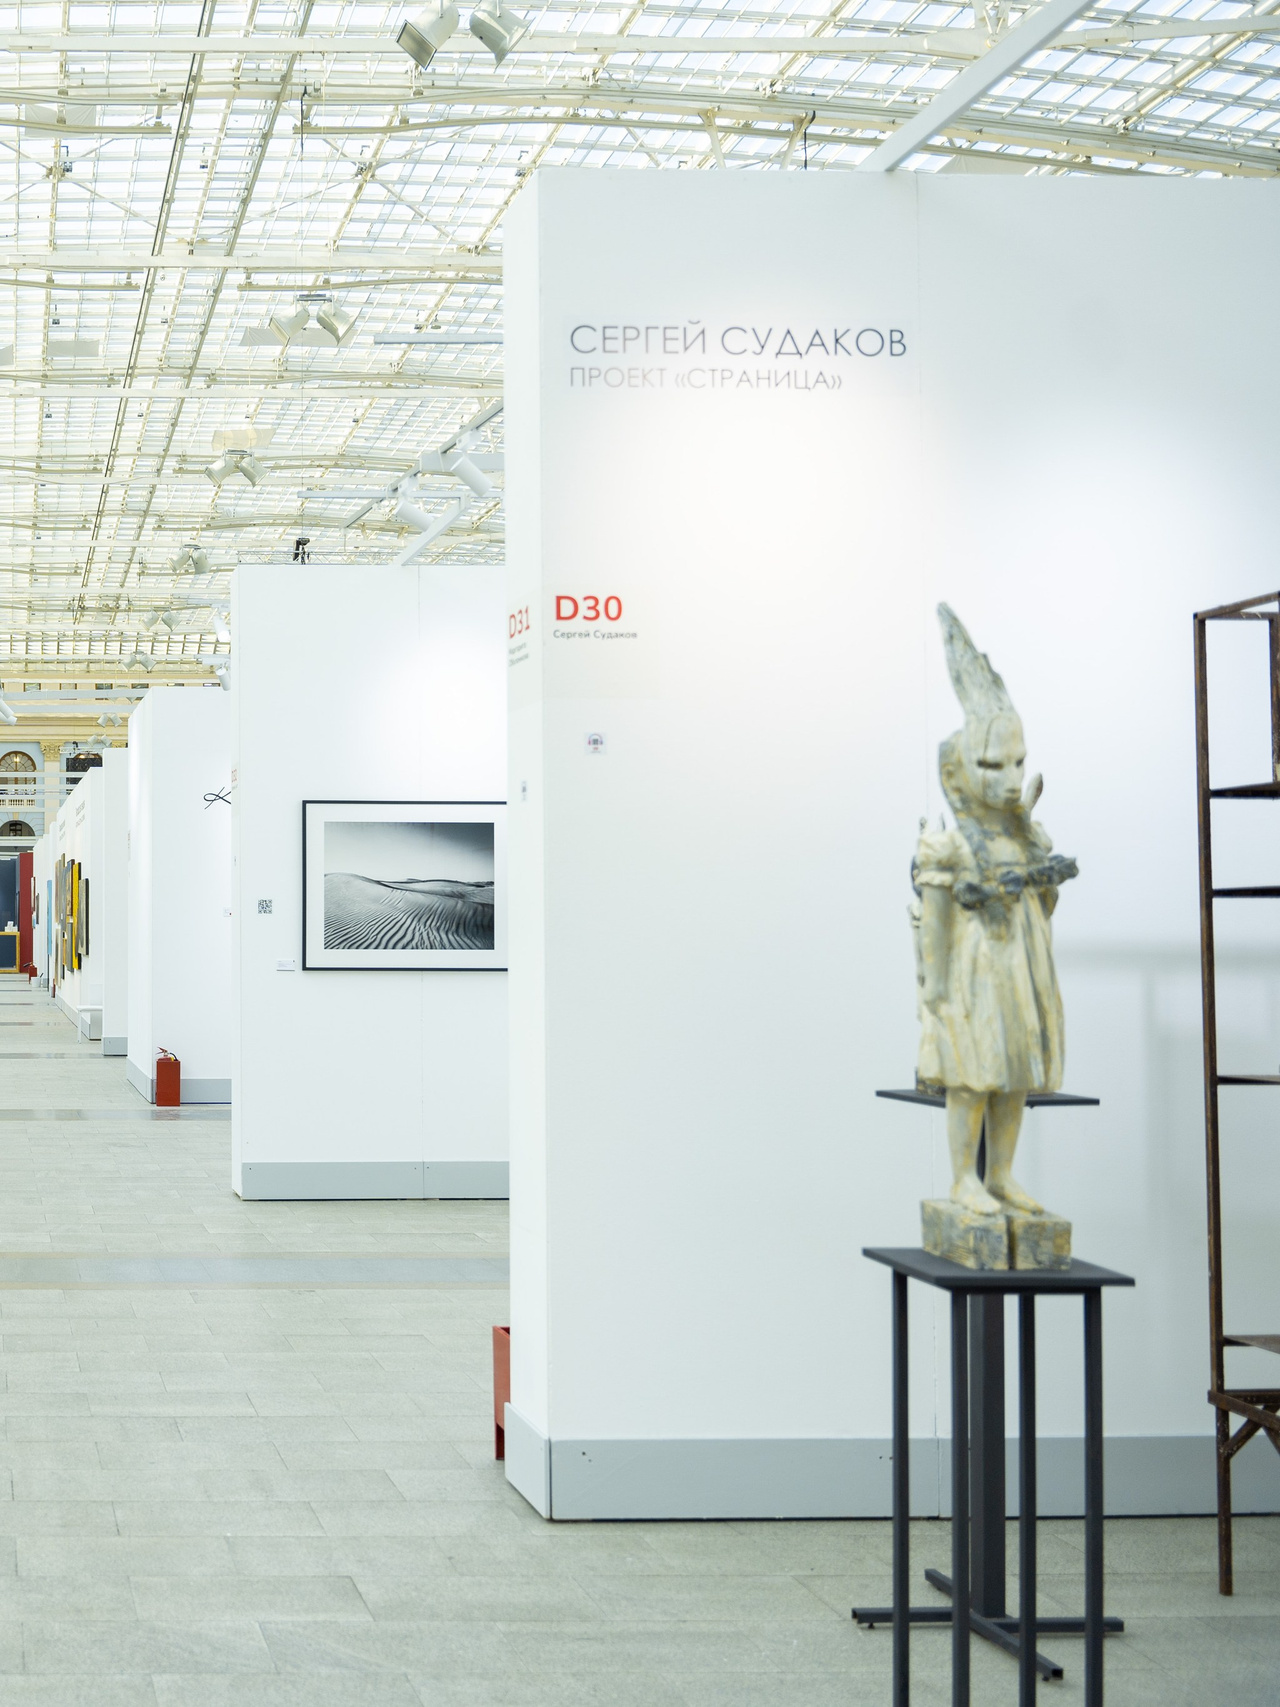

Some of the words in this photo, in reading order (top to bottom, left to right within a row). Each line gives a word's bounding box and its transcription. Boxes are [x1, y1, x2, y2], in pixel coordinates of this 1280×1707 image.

[569, 320, 706, 355] СЕРГЕЙ
[720, 326, 908, 360] СУДАКОВ
[569, 366, 667, 388] ПРОЕКТ
[674, 367, 843, 392] «СТРАНИЦА»
[555, 595, 623, 622] D30
[508, 605, 531, 640] D31
[553, 629, 590, 640] Сергей
[593, 629, 638, 640] Судаков
